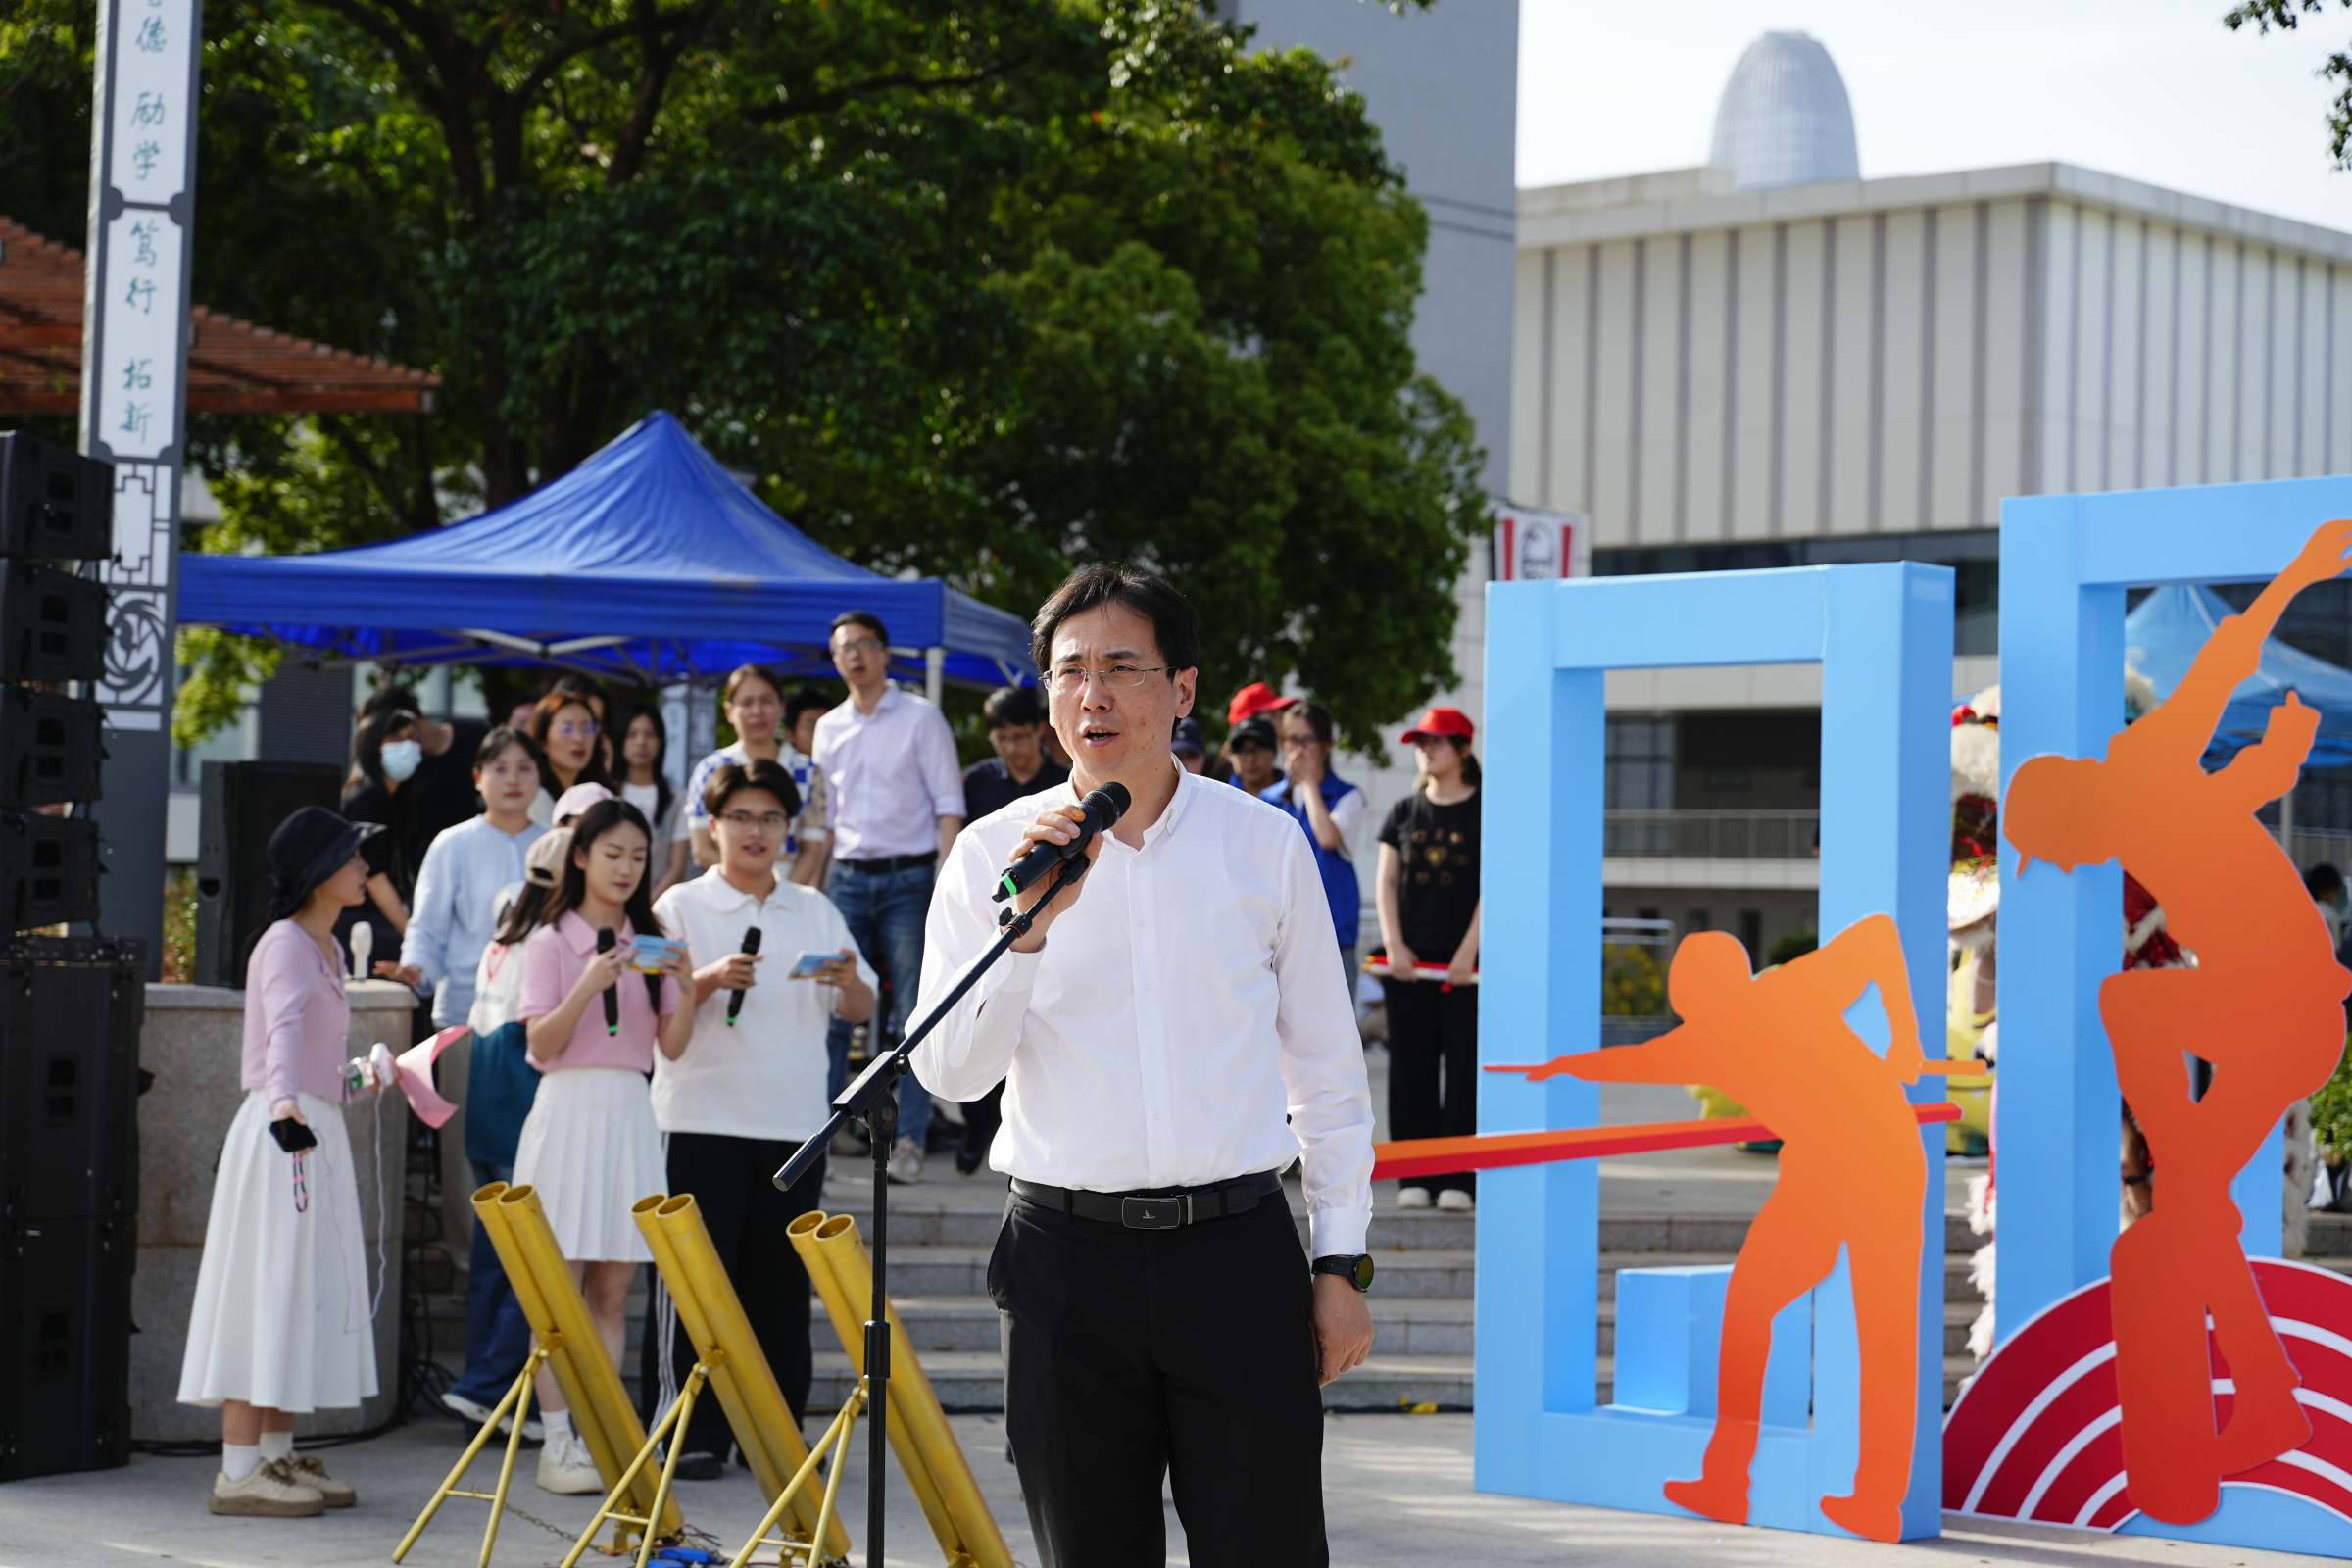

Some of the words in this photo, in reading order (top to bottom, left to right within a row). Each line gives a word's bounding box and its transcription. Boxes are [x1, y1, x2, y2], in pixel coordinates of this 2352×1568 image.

[134, 0, 168, 52] 德
[128, 91, 165, 181] 励学
[124, 219, 159, 316] 笃行
[118, 358, 153, 445] 拓新
